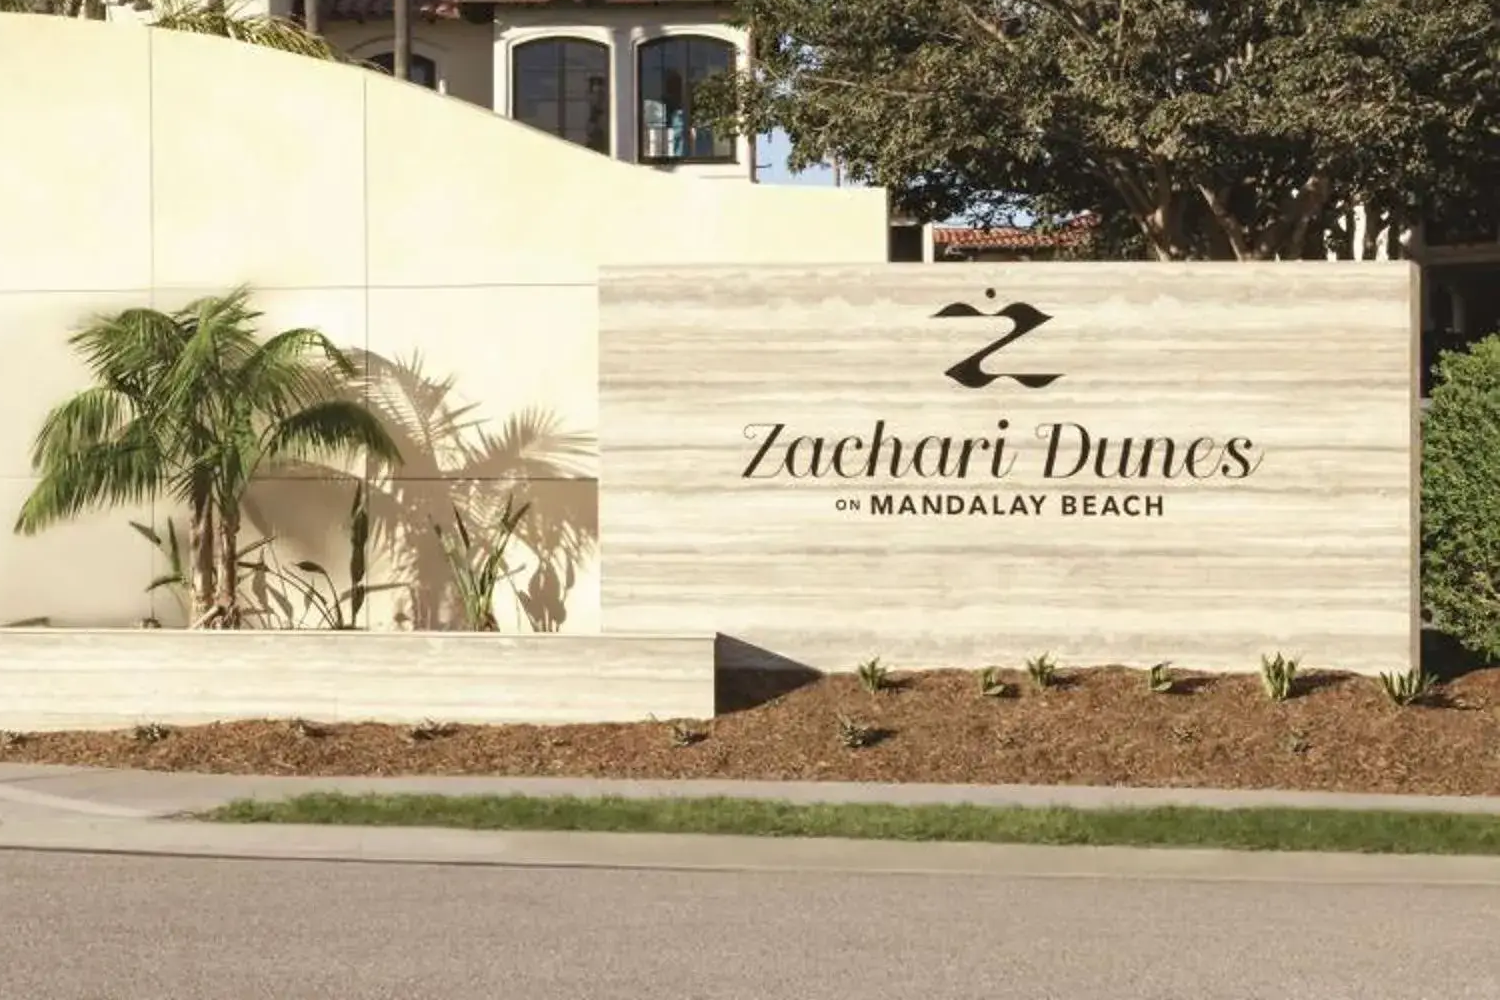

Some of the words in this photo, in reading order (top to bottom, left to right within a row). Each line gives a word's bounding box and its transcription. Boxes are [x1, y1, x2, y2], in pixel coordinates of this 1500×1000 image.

[741, 418, 1018, 479] Zachari
[1035, 421, 1264, 480] Dunes
[835, 498, 861, 511] ON
[870, 494, 1047, 516] MANDALAY
[1061, 494, 1165, 517] BEACH
